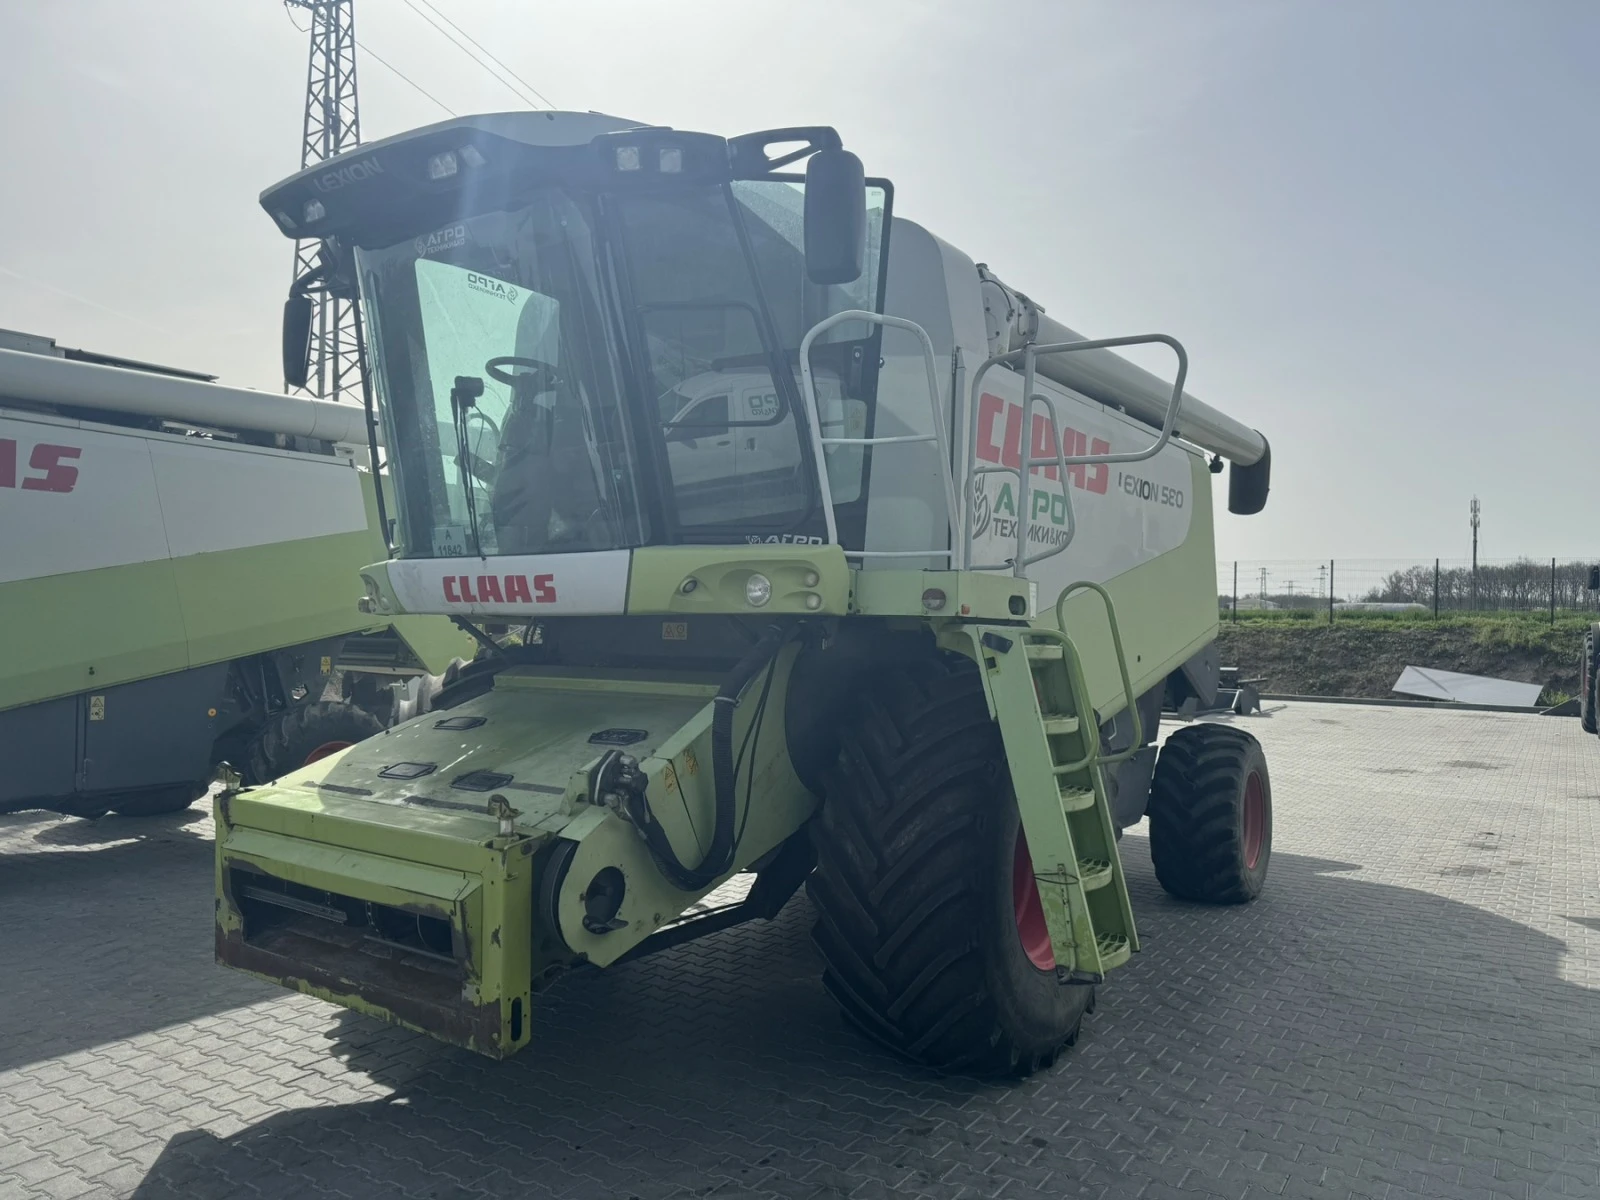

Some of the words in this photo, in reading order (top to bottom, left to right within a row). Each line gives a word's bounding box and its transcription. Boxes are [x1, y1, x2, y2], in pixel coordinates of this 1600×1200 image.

[312, 156, 385, 192] LEXION
[427, 225, 465, 246] АГРО
[976, 392, 1110, 495] CLAAS
[993, 482, 1066, 525] АРО
[993, 518, 1069, 546] ТЕХИКИ&КО
[438, 544, 462, 556] 11842
[443, 574, 557, 603] CLAAS
